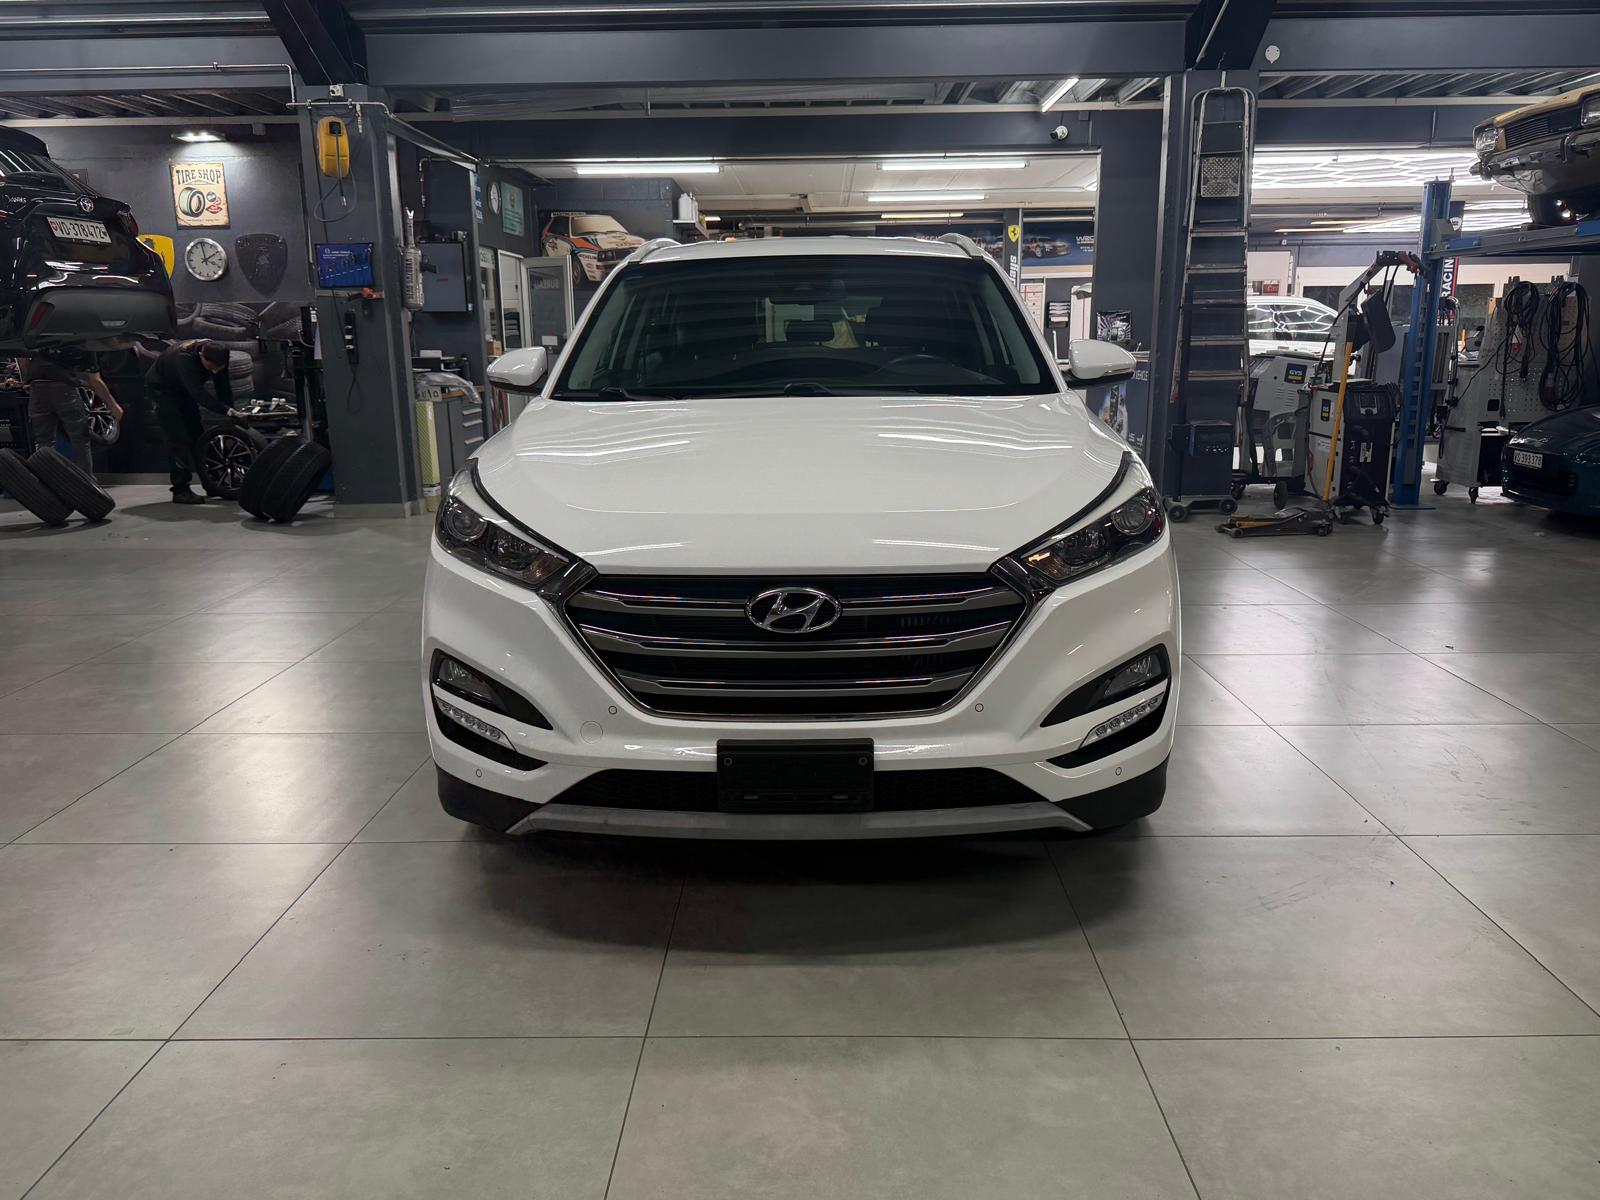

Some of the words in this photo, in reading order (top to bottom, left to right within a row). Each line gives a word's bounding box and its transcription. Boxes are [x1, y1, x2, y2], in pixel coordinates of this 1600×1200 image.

[176, 169, 197, 185] TIRE
[197, 168, 222, 184] SHOP
[1441, 256, 1456, 297] RACIN
